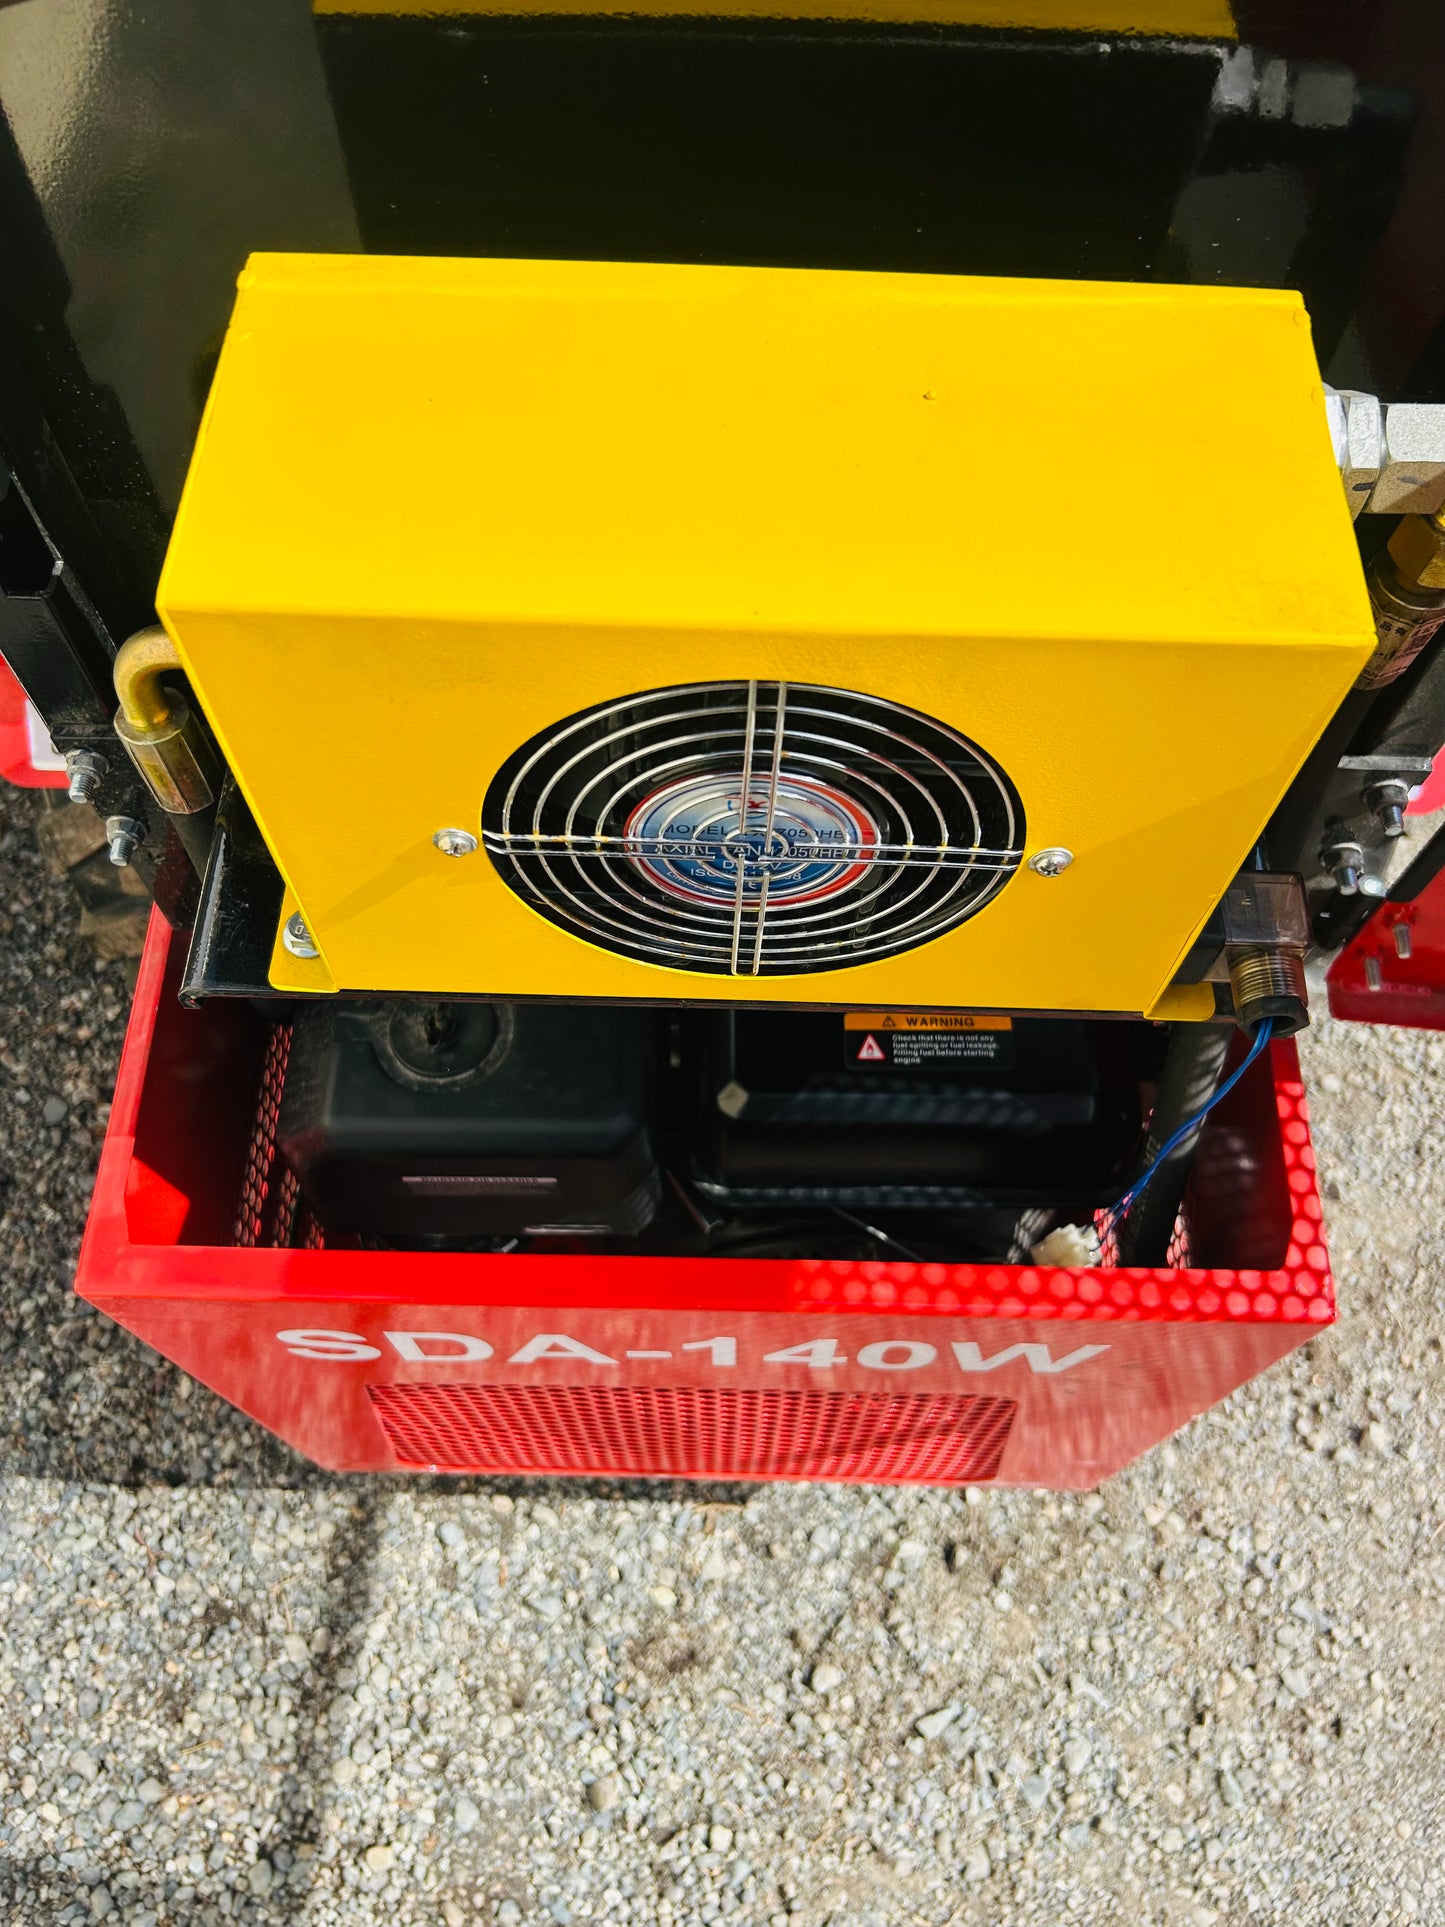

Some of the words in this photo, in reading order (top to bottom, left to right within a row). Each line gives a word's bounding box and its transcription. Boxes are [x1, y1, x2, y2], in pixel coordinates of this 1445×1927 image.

[720, 844, 761, 857] AN
[905, 1016, 975, 1027] WARNING
[963, 1049, 994, 1058] starting
[276, 1328, 1112, 1373] SDA-140W
